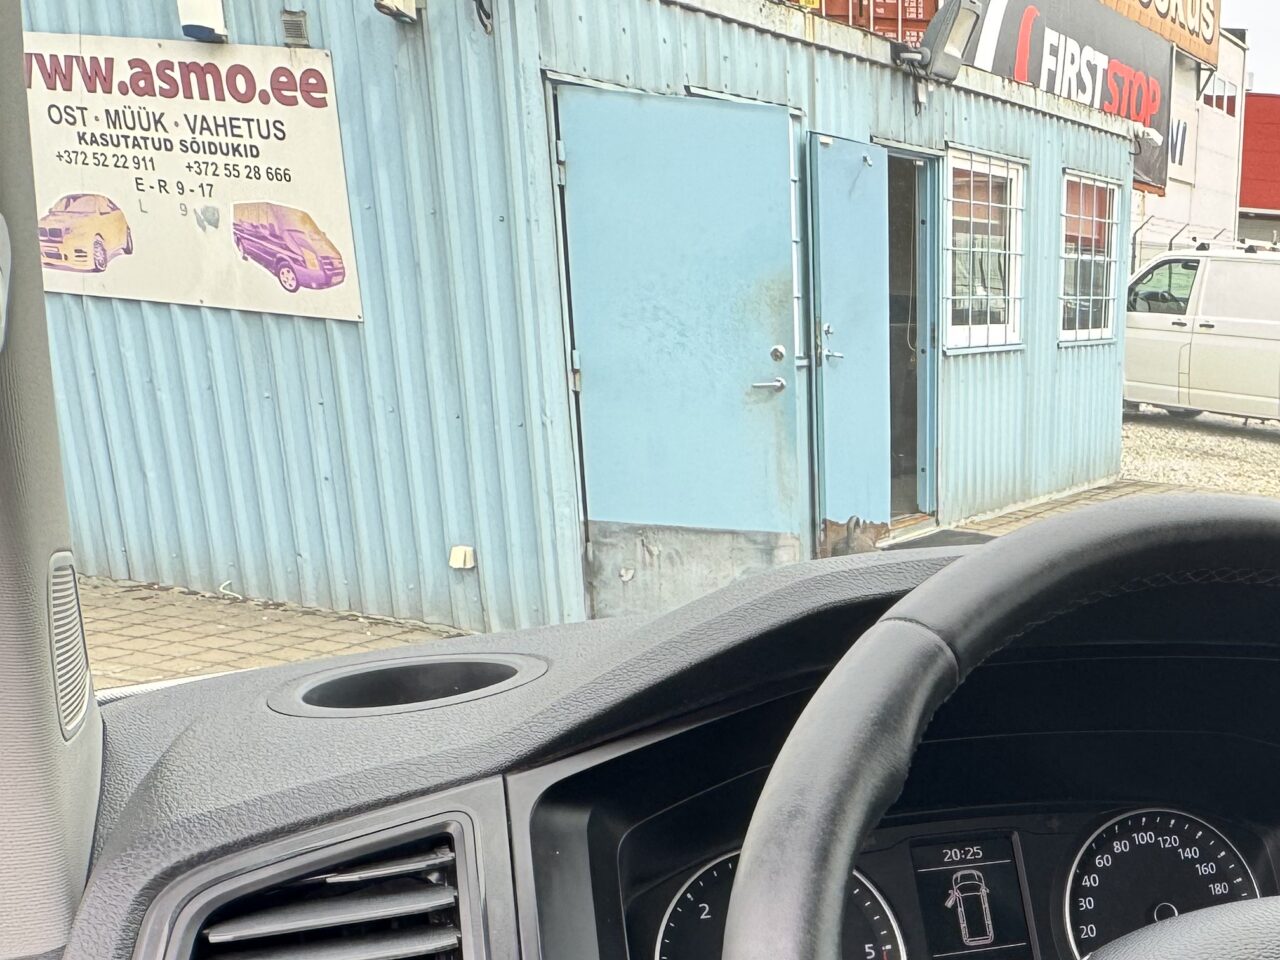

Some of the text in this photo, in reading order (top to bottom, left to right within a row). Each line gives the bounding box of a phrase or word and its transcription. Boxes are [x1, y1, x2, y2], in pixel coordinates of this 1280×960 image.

[24, 51, 329, 109] ww.asmo.ee
[1039, 26, 1162, 128] FIRST STOP
[47, 104, 286, 141] OST MÜÜK VAHETUS
[77, 131, 260, 158] KASUTATUD SÕIDUKID
[56, 150, 156, 171] +372 52 22 911
[185, 160, 292, 182] +372 55 28 666
[1132, 832, 1155, 845] 100
[1157, 835, 1179, 848] 120
[942, 846, 983, 861] 20:25
[1113, 840, 1129, 853] 80
[1178, 847, 1199, 860] 140
[1095, 854, 1112, 867] 60
[1195, 863, 1216, 876] 160
[1081, 874, 1099, 887] 40
[1208, 882, 1229, 896] 180
[1078, 897, 1094, 910] 30
[698, 903, 712, 919] 2
[1079, 924, 1096, 938] 20
[864, 943, 876, 959] 5
